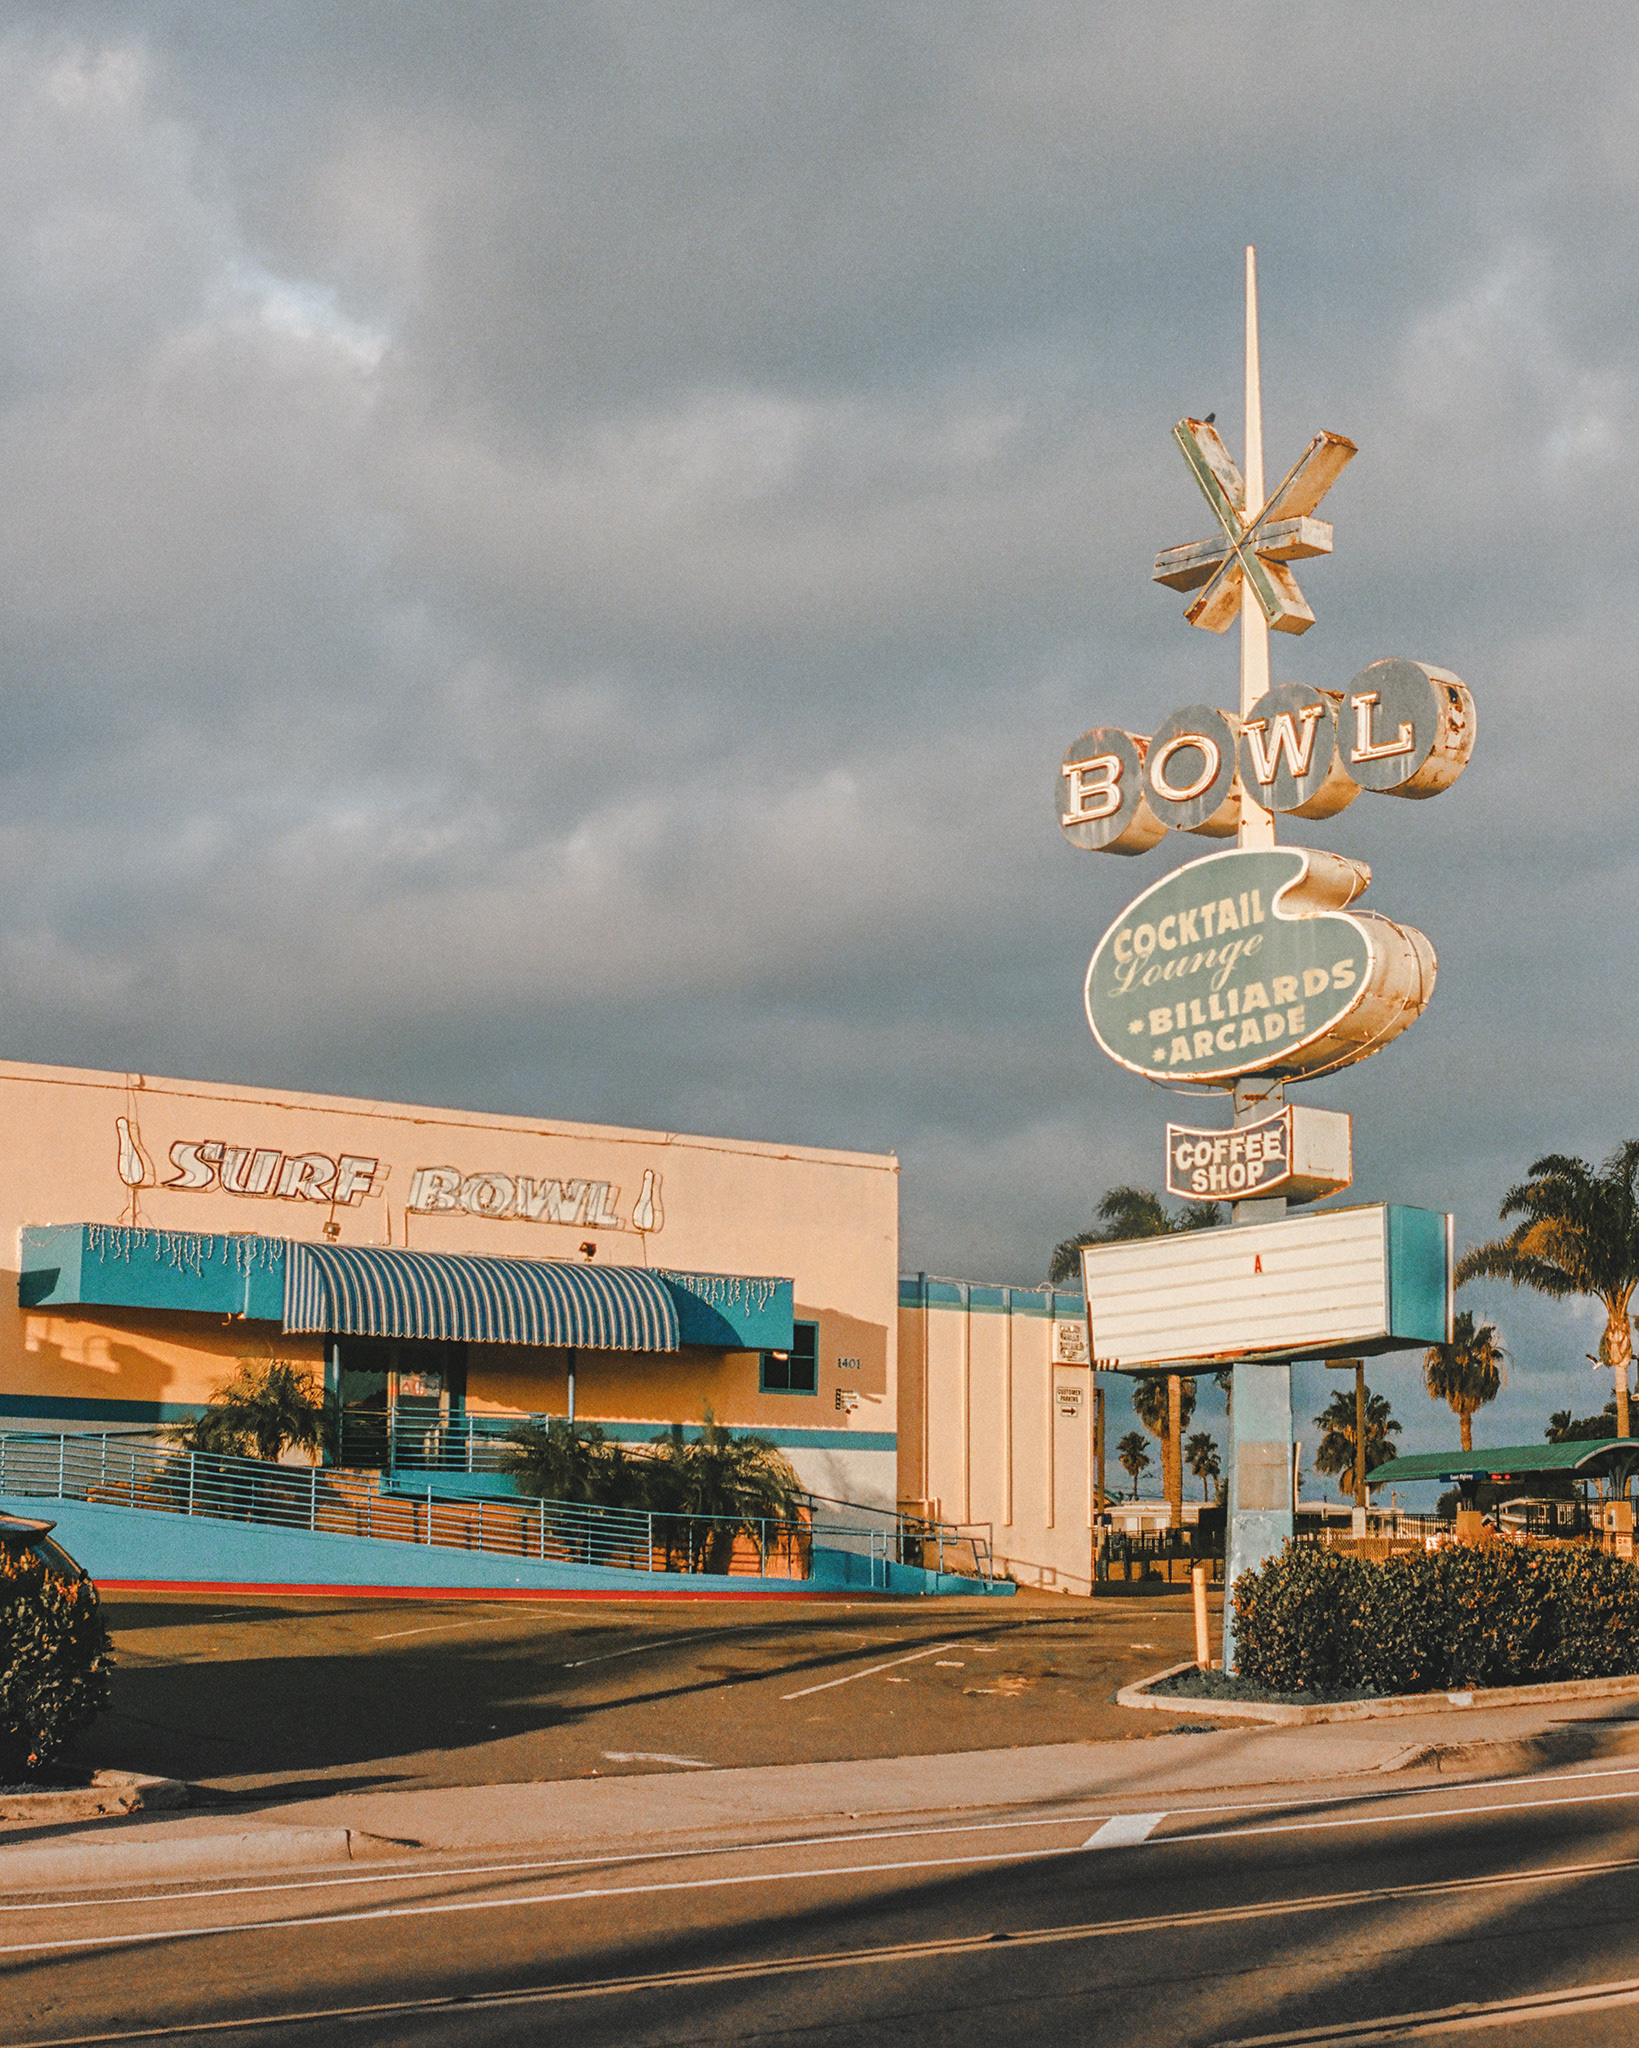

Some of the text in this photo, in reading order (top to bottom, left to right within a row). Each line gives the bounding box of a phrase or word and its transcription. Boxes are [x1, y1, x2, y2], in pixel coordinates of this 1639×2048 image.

[1061, 692, 1416, 826] BOWL
[1113, 888, 1266, 964] COCKTAIL
[1107, 934, 1264, 998] Lounge
[1148, 959, 1357, 1036] BILLIARDS
[1168, 1004, 1306, 1066] ARCADE
[1174, 1130, 1282, 1171] COFFEE
[1191, 1160, 1265, 1193] SHOP
[161, 1139, 620, 1229] SURF BOWL
[1254, 1254, 1263, 1274] A
[837, 1358, 860, 1369] 1401
